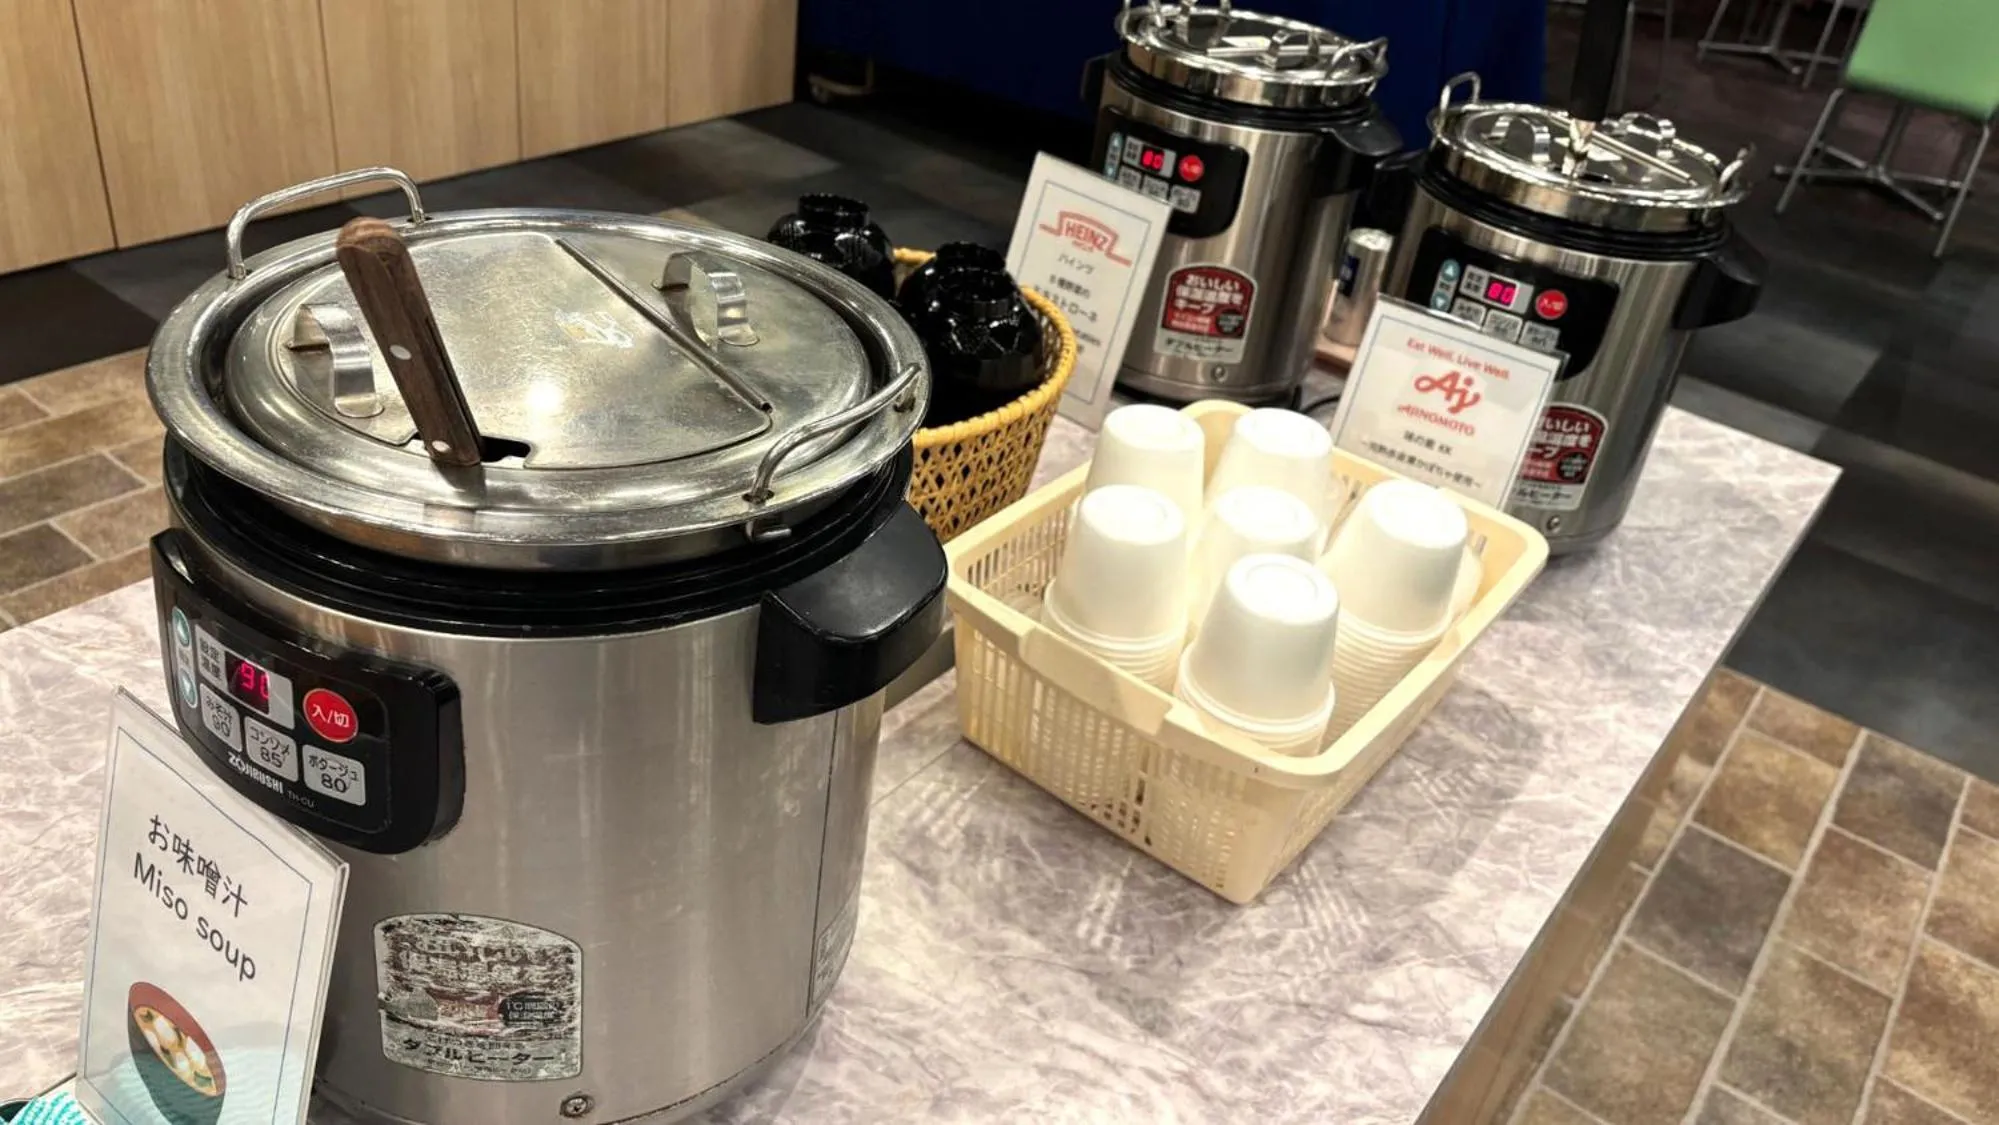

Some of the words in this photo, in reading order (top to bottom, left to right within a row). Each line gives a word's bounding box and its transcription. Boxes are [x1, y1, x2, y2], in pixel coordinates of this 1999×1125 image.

[1065, 220, 1109, 251] HEINZ
[1407, 337, 1425, 352] Eat
[1457, 353, 1481, 370] Live
[311, 703, 350, 728] 入/切
[228, 751, 284, 794] ZOJIRUSHI
[260, 747, 283, 769] 85
[308, 754, 358, 781] ポタージュ
[321, 773, 347, 793] 80
[148, 814, 248, 917] お味噌汁
[134, 851, 188, 920] Miso
[195, 916, 256, 982] soup
